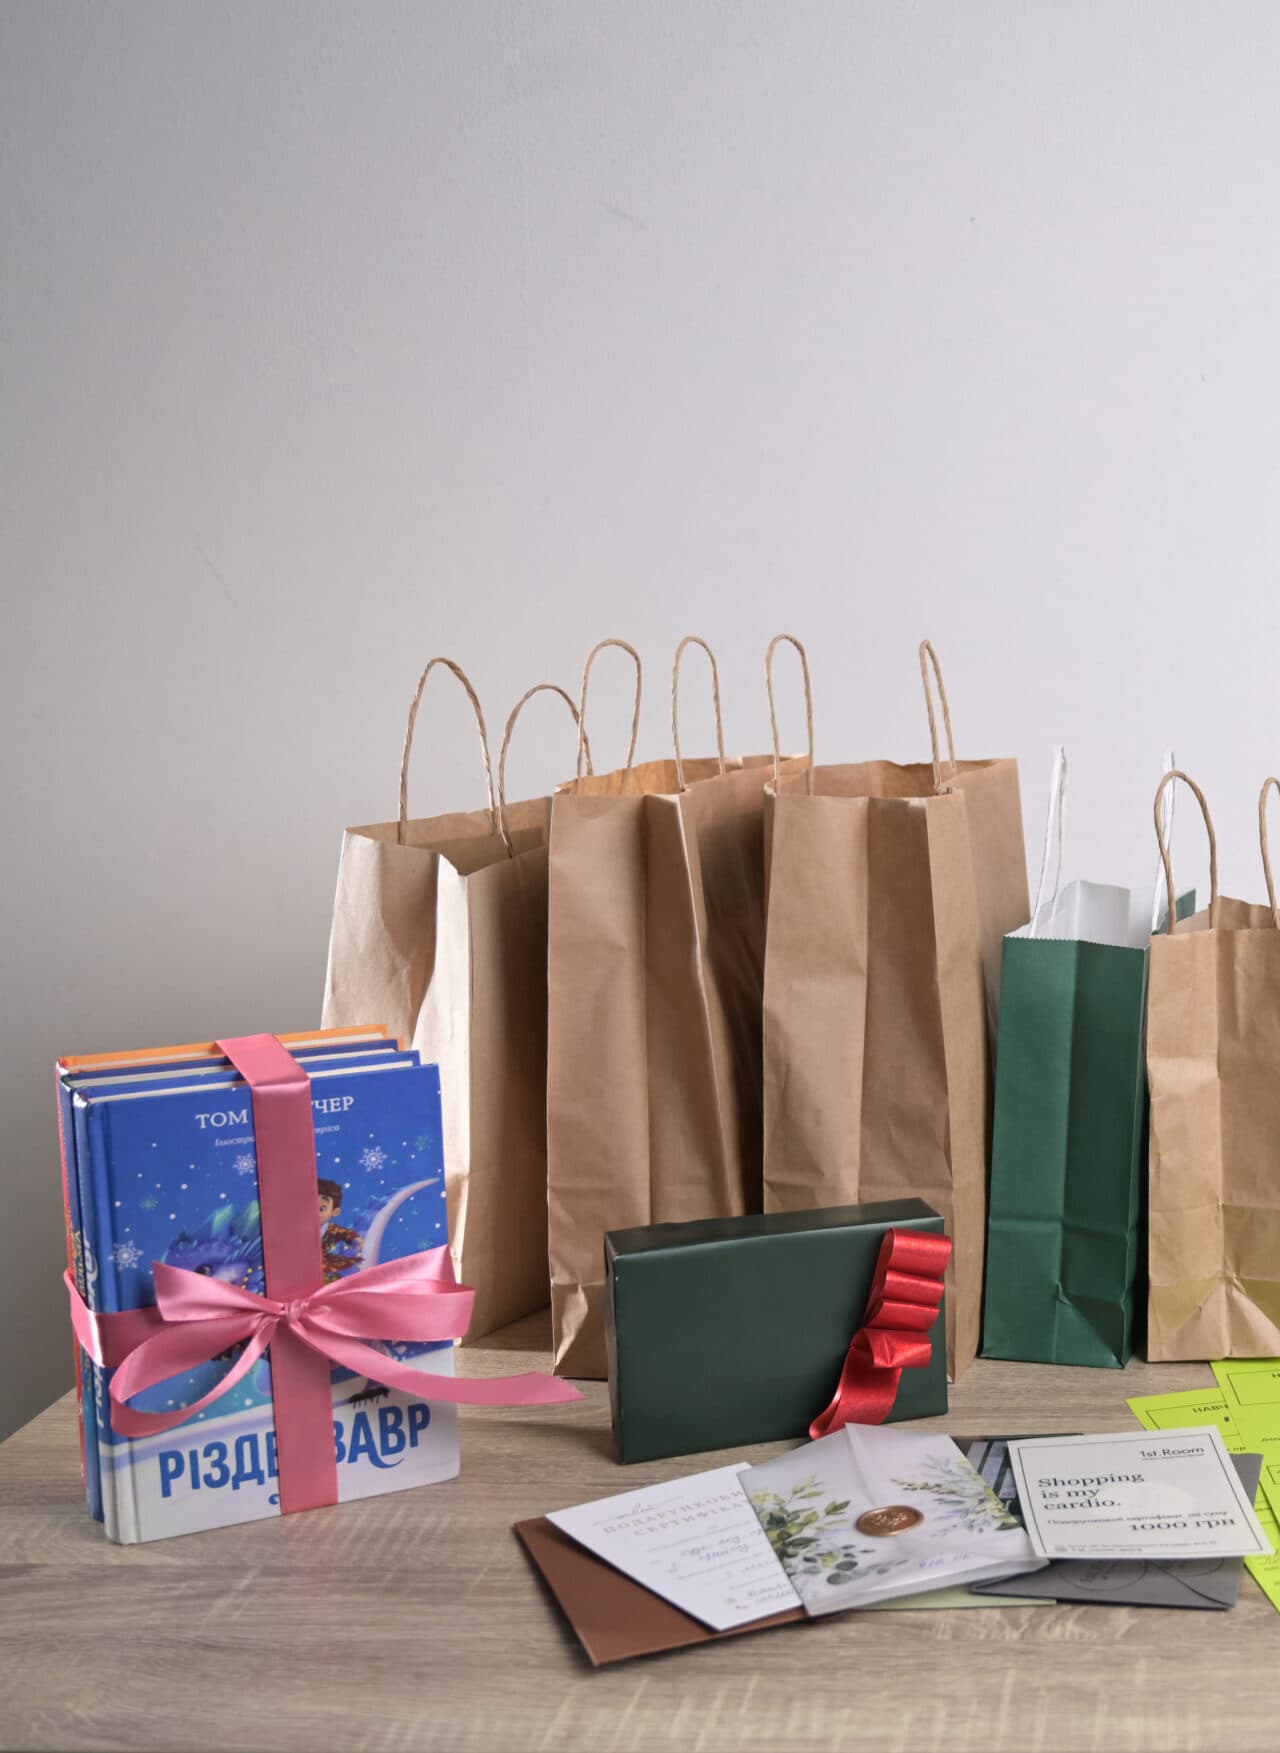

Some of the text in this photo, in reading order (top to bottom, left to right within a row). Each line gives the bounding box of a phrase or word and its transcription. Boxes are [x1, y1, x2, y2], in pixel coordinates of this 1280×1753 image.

[196, 1096, 354, 1129] ТОМ ЧЕР
[1038, 1472, 1145, 1488] Shopping
[1041, 1488, 1100, 1499] is my
[1044, 1499, 1121, 1511] cardio.
[1131, 1518, 1235, 1531] 1000 грн
